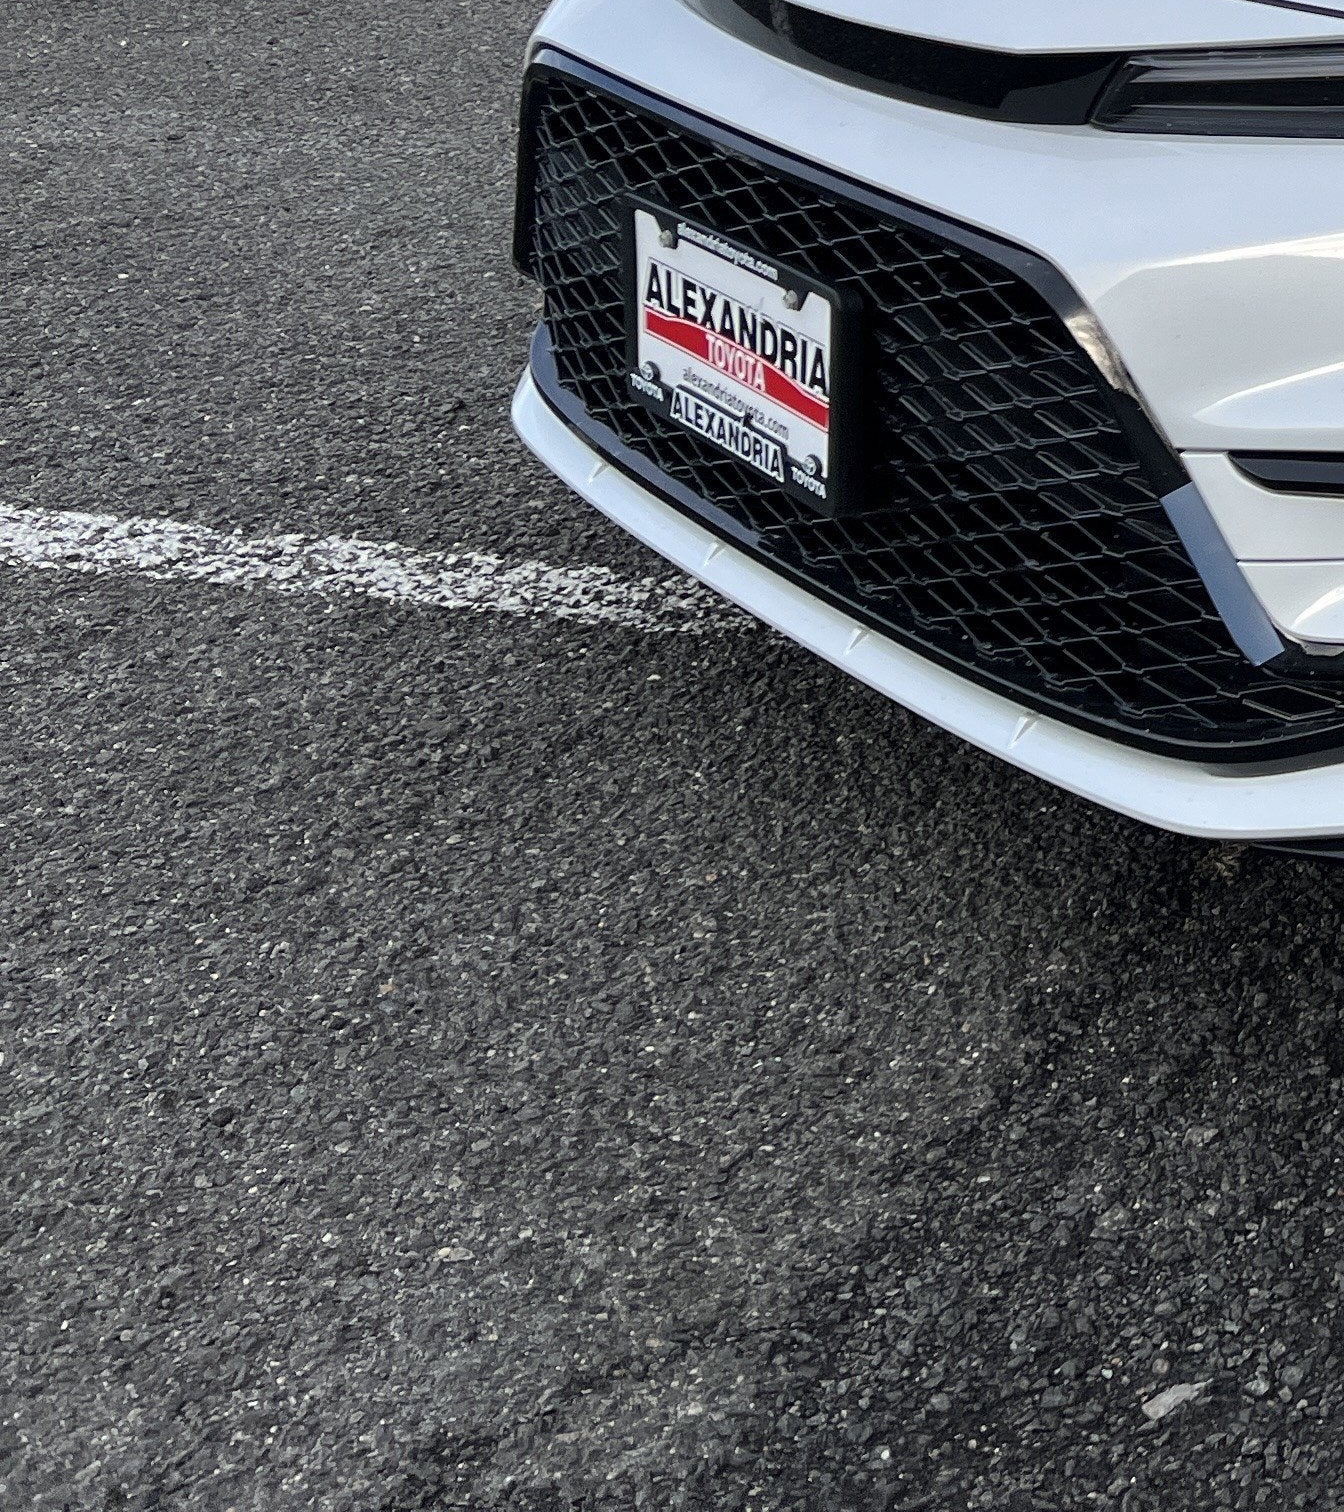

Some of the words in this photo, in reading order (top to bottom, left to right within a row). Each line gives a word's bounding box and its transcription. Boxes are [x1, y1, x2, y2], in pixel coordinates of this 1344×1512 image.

[645, 262, 830, 392] ALEXANDRIA
[630, 373, 665, 402] TOYOTA
[705, 334, 767, 394] TOYOTA
[671, 390, 783, 482] ALEXANDRIA
[791, 466, 826, 499] TOYOTA
